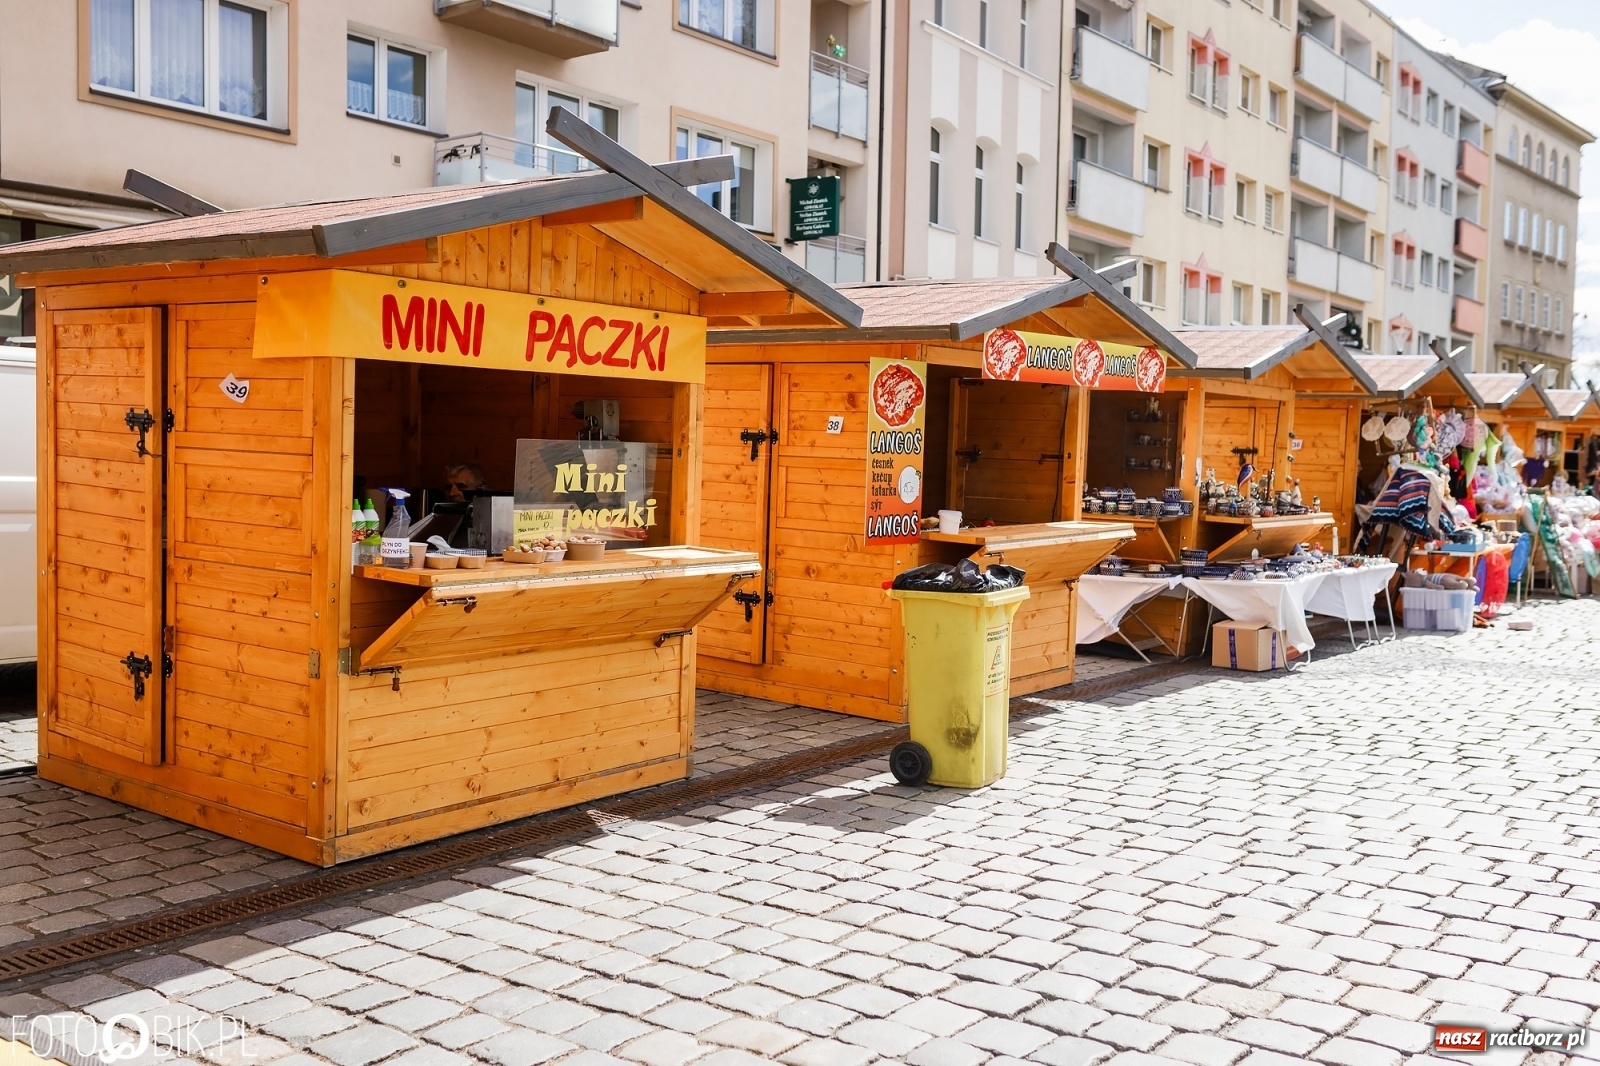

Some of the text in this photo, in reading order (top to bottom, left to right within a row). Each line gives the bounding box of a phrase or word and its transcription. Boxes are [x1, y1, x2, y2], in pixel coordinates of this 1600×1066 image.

[381, 293, 670, 372] MINI PĄCZKI
[1026, 345, 1073, 372] LANGOŠ
[1104, 354, 1138, 378] LANGOŠ
[226, 381, 248, 398] 39
[827, 420, 840, 431] 38
[869, 428, 923, 455] LANGOŠ
[871, 458, 894, 469] česnek
[553, 462, 628, 494] Mini
[871, 471, 893, 487] kečup
[871, 485, 897, 497] tatarka
[565, 498, 659, 538] pączki
[870, 499, 883, 513] sýr
[867, 510, 919, 539] LANGOŠ
